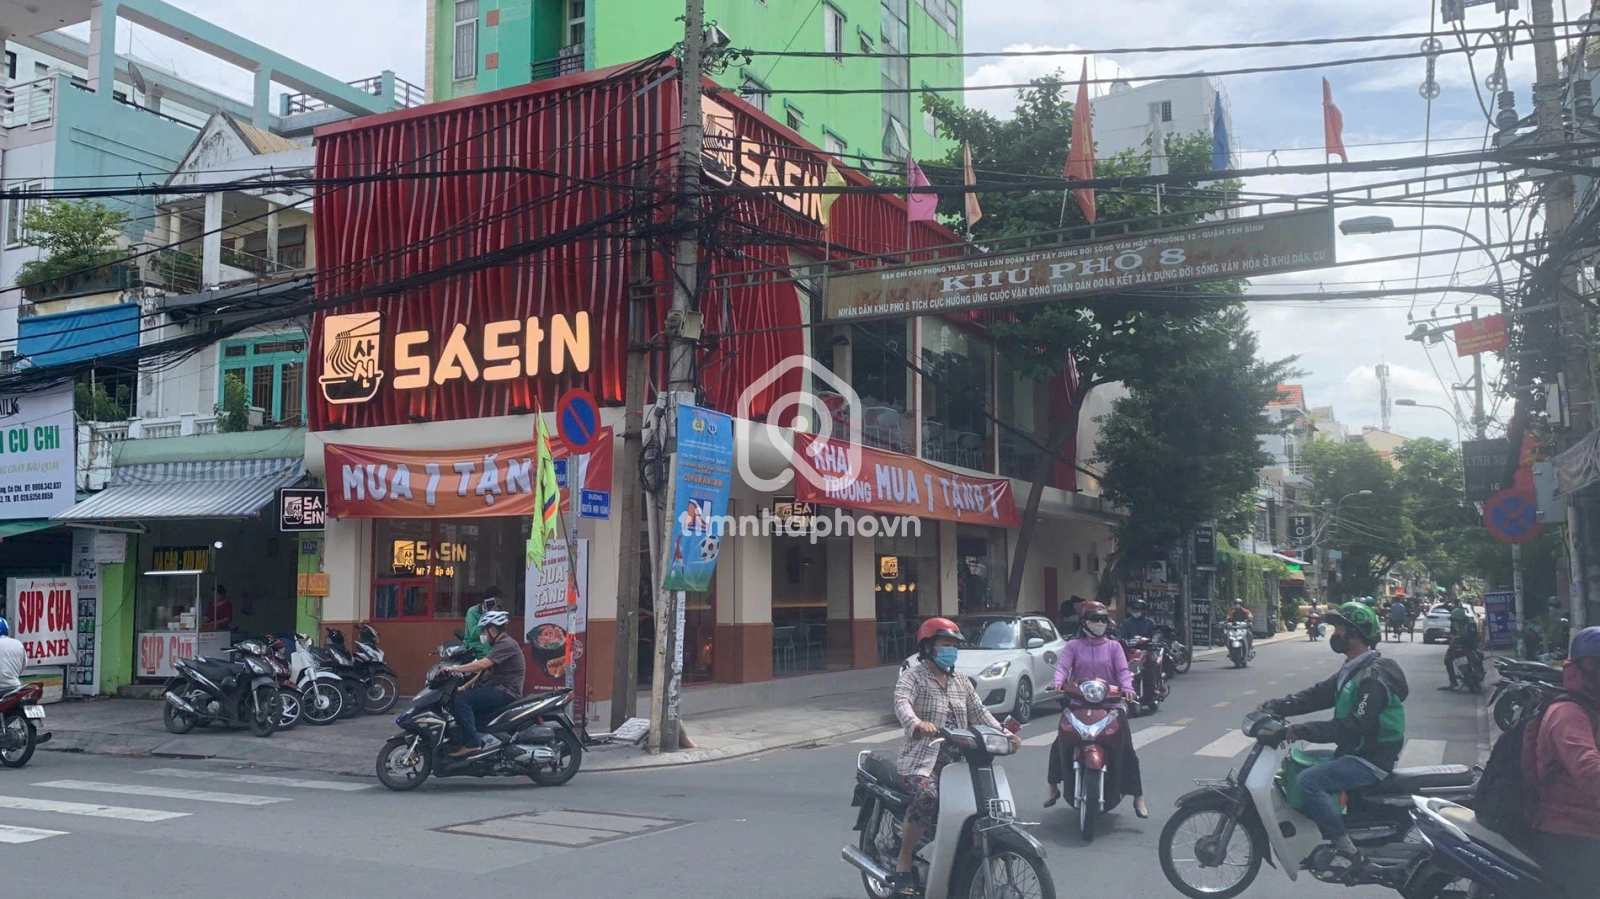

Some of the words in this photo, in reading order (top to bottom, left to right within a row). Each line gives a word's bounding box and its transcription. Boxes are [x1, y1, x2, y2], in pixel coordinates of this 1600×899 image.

[923, 266, 946, 274] PHONG
[989, 258, 1004, 266] DÂN
[1042, 252, 1056, 260] XÂY
[1202, 228, 1225, 239] QUẬN
[1226, 226, 1242, 235] TÂN
[1244, 223, 1264, 232] BÌNH
[940, 266, 1034, 292] KHU
[1048, 246, 1146, 280] PHỐ
[1159, 248, 1187, 265] 8
[838, 306, 857, 317] NHÂN
[859, 303, 873, 314] DÂN
[874, 304, 889, 314] KHU
[890, 298, 904, 312] PHỐ
[912, 298, 928, 309] TÍCH
[990, 288, 1010, 302] CUỘC
[1012, 286, 1028, 300] VẬN
[1029, 284, 1050, 298] ĐỘNG
[1052, 281, 1074, 293] TOÀN
[1075, 278, 1092, 290] DÂN
[1093, 276, 1116, 288] ĐOÀN
[1117, 274, 1134, 286] KẾT
[1136, 270, 1152, 283] XÂY
[1154, 268, 1178, 282] DỰNG
[1196, 261, 1219, 275] SỐNG
[1221, 260, 1239, 272] VĂN
[1242, 256, 1261, 270] HÓA
[1271, 255, 1290, 266] KHU
[1292, 251, 1310, 264] DÂN
[353, 339, 376, 388] 사신
[393, 310, 590, 390] SASIN
[342, 462, 414, 501] MUA
[424, 462, 442, 506] 1
[454, 452, 532, 506] TẶN
[814, 441, 853, 476] KHAI
[304, 496, 322, 510] SA
[876, 463, 920, 506] MUA
[922, 473, 934, 514] 1
[939, 474, 986, 518] TẶNG
[304, 511, 324, 524] SIN
[18, 582, 44, 634] SÚP
[47, 590, 73, 632] CUA
[141, 632, 164, 670] SÚP
